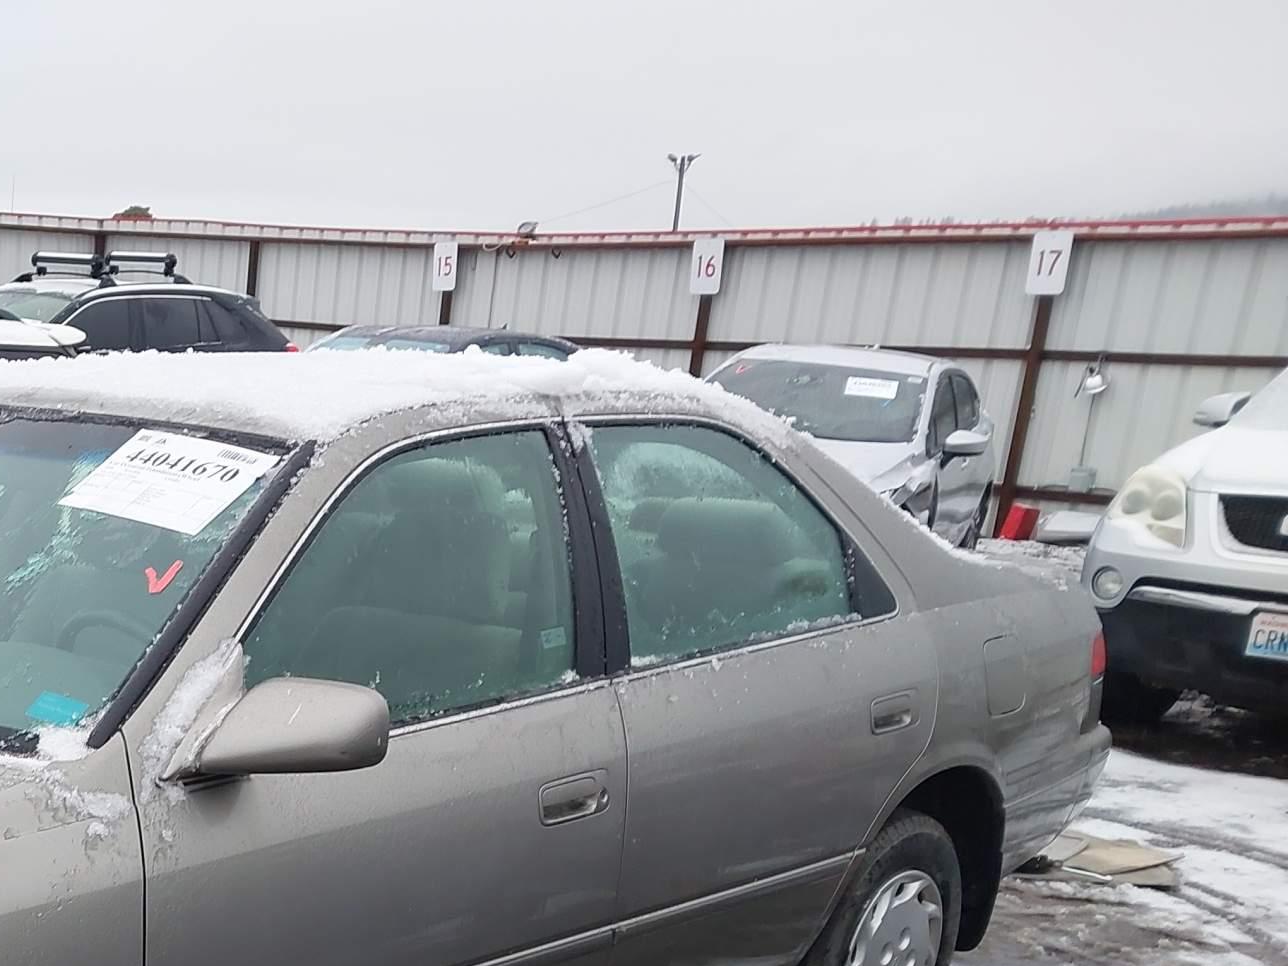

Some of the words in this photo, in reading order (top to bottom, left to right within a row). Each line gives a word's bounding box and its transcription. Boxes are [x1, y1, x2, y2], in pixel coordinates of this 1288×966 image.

[438, 256, 452, 277] 15
[697, 254, 716, 278] 16
[1037, 250, 1063, 276] 17
[126, 448, 240, 483] 44041670
